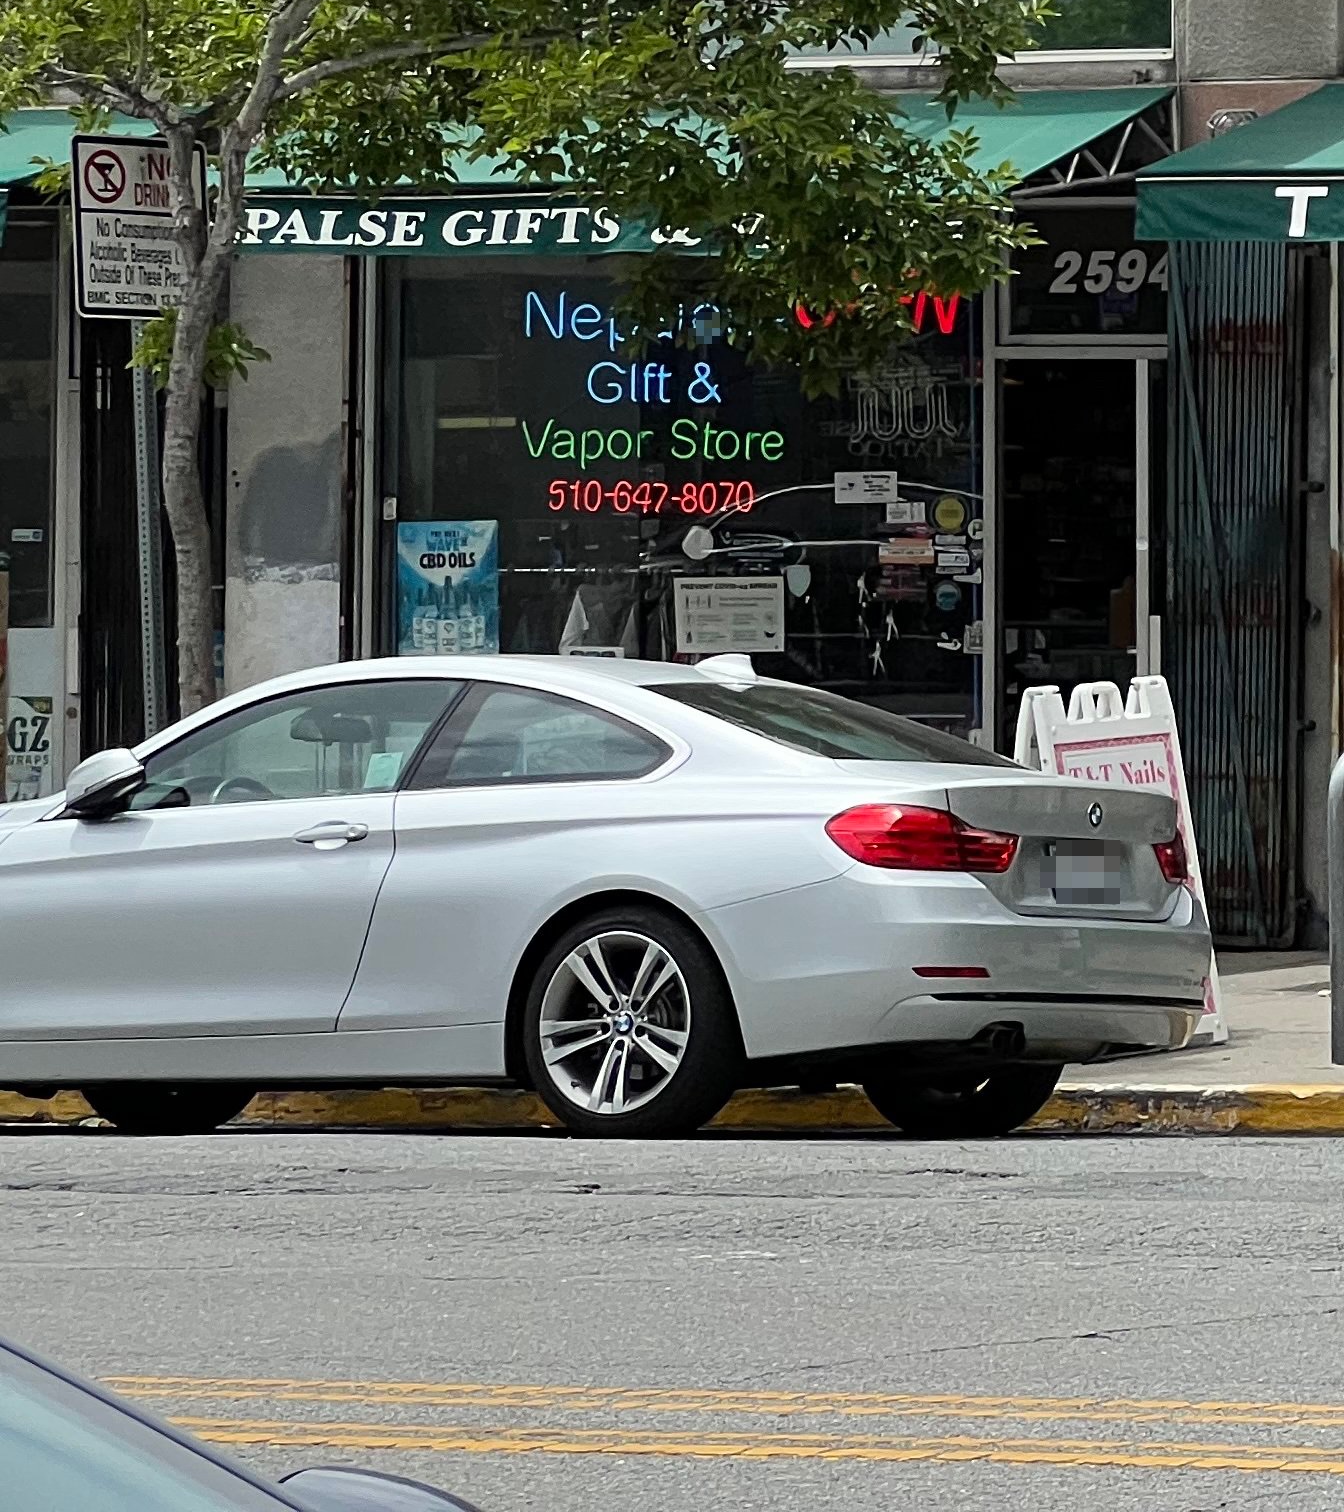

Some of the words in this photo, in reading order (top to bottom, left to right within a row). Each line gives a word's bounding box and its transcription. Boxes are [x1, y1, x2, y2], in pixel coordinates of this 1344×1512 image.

[147, 153, 171, 181] N
[96, 218, 110, 237] No
[233, 207, 426, 247] PALSE
[442, 206, 620, 247] GIFTS
[1275, 185, 1327, 239] T
[1048, 249, 1169, 294] 2594
[87, 290, 110, 304] BMC
[687, 361, 722, 404] &
[521, 418, 654, 471] Vapor
[670, 418, 785, 461] Store
[547, 480, 755, 515] 510-647-8070
[420, 553, 446, 569] CBD
[448, 552, 476, 569] OILS
[8, 716, 50, 752] GZ
[1120, 759, 1166, 785] Nails
